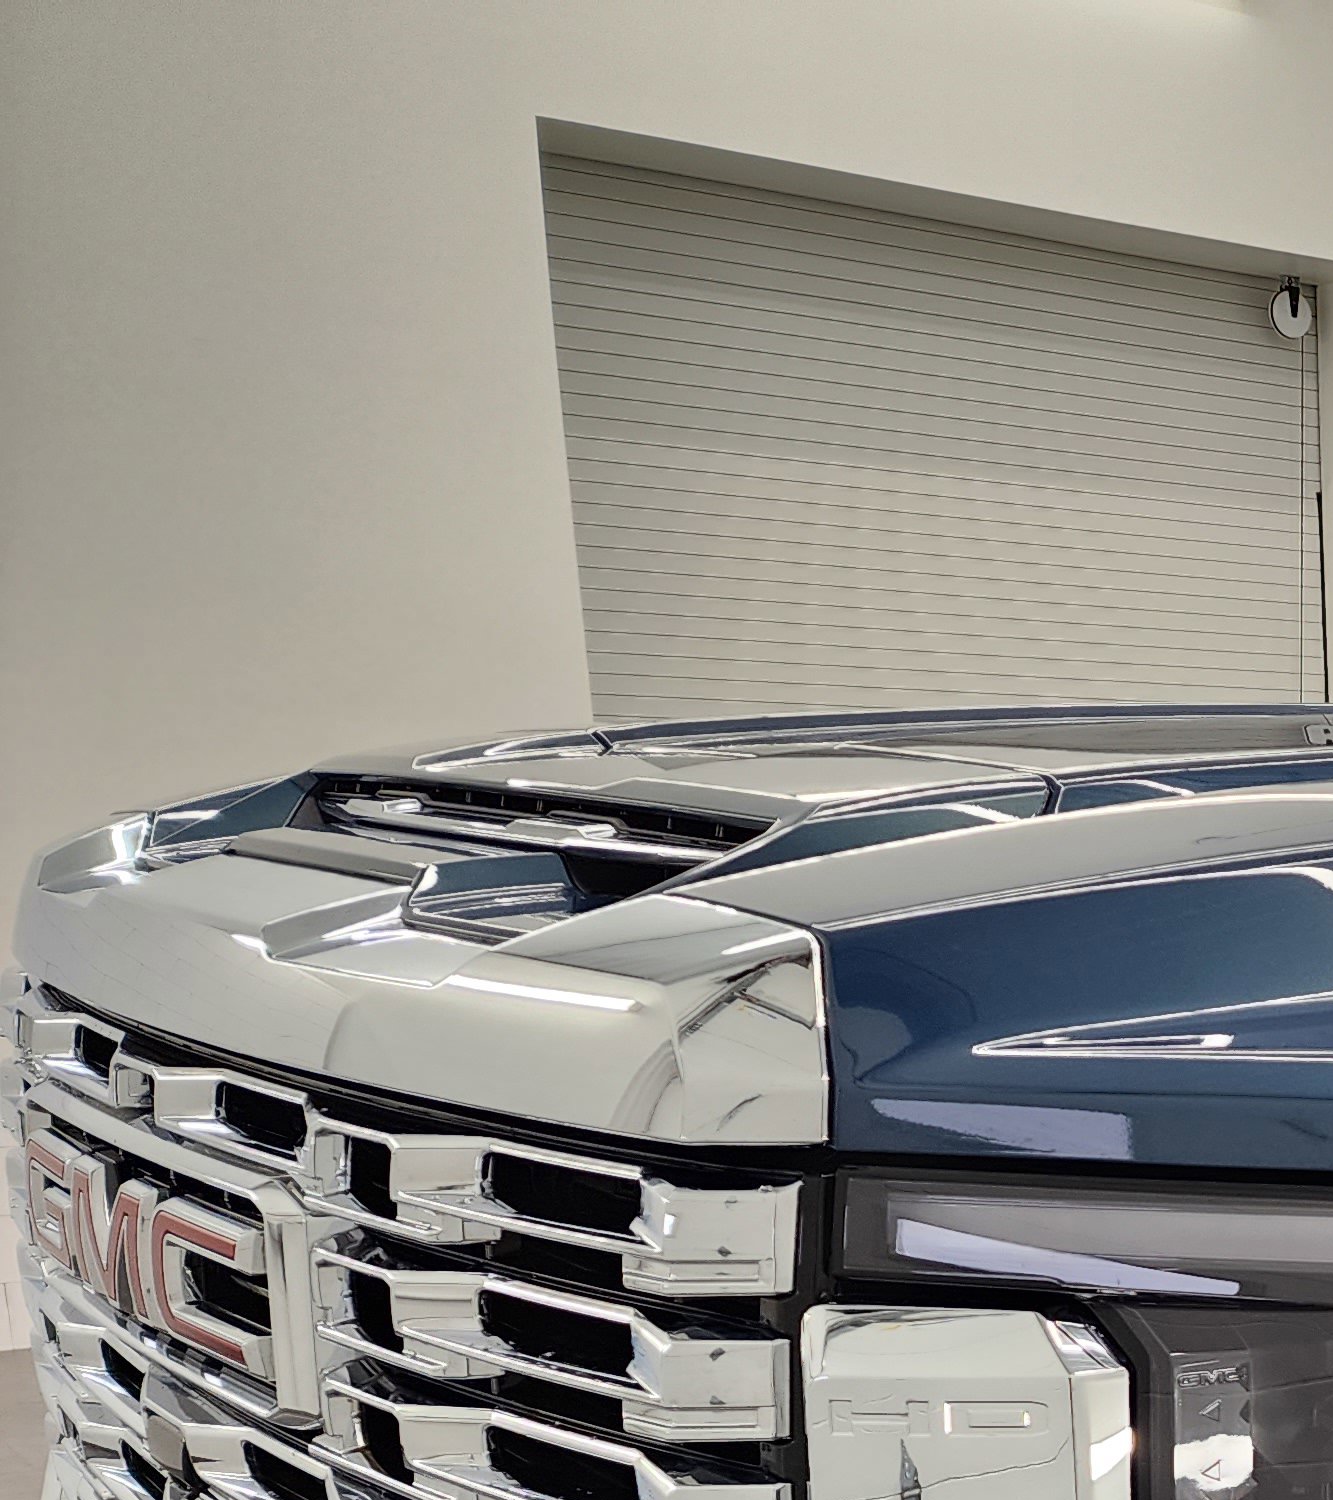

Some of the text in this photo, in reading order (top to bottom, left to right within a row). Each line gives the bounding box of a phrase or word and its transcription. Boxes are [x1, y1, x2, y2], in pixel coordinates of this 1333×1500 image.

[24, 1128, 273, 1380] GMC
[1176, 1367, 1241, 1389] GMC
[828, 1398, 1050, 1438] HD
